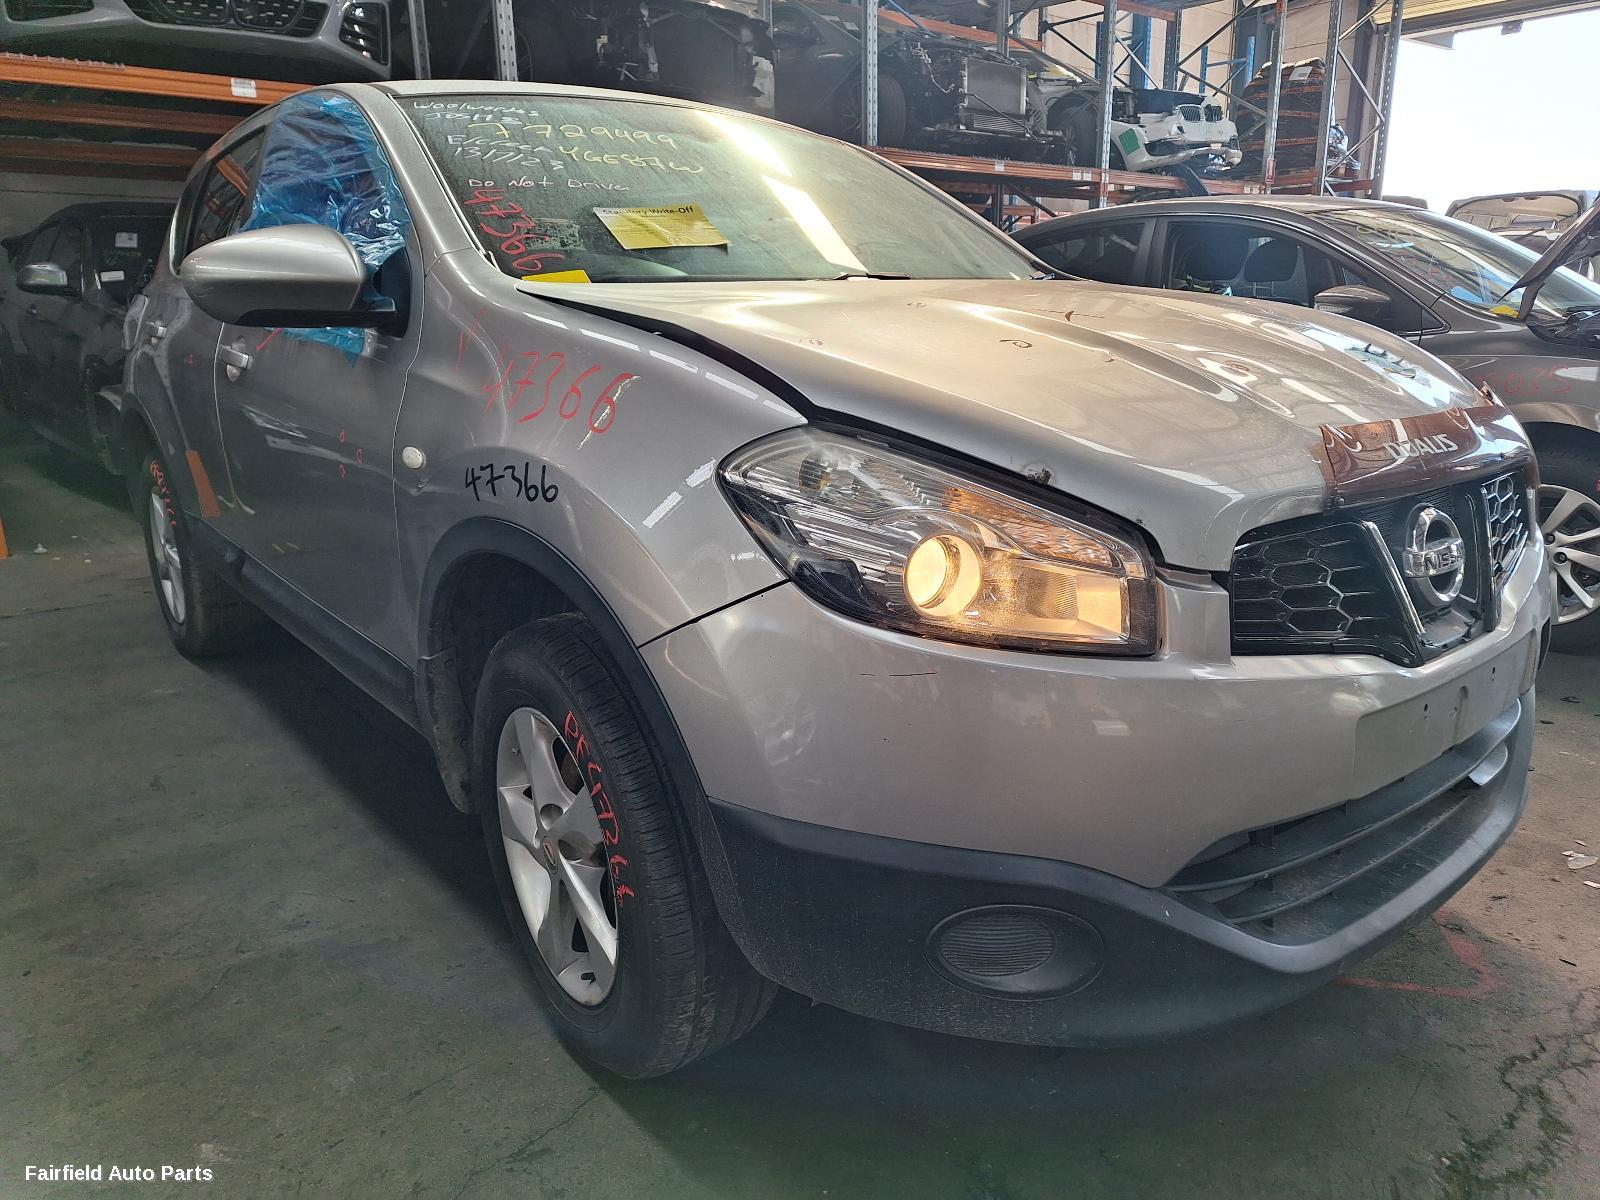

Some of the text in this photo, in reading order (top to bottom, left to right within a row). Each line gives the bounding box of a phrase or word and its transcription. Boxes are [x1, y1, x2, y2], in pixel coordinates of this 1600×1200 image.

[467, 121, 678, 150] 7729499
[463, 188, 566, 271] 47366
[1383, 433, 1459, 460] DUALIS
[464, 461, 559, 502] 47366
[1423, 545, 1464, 571] NISS
